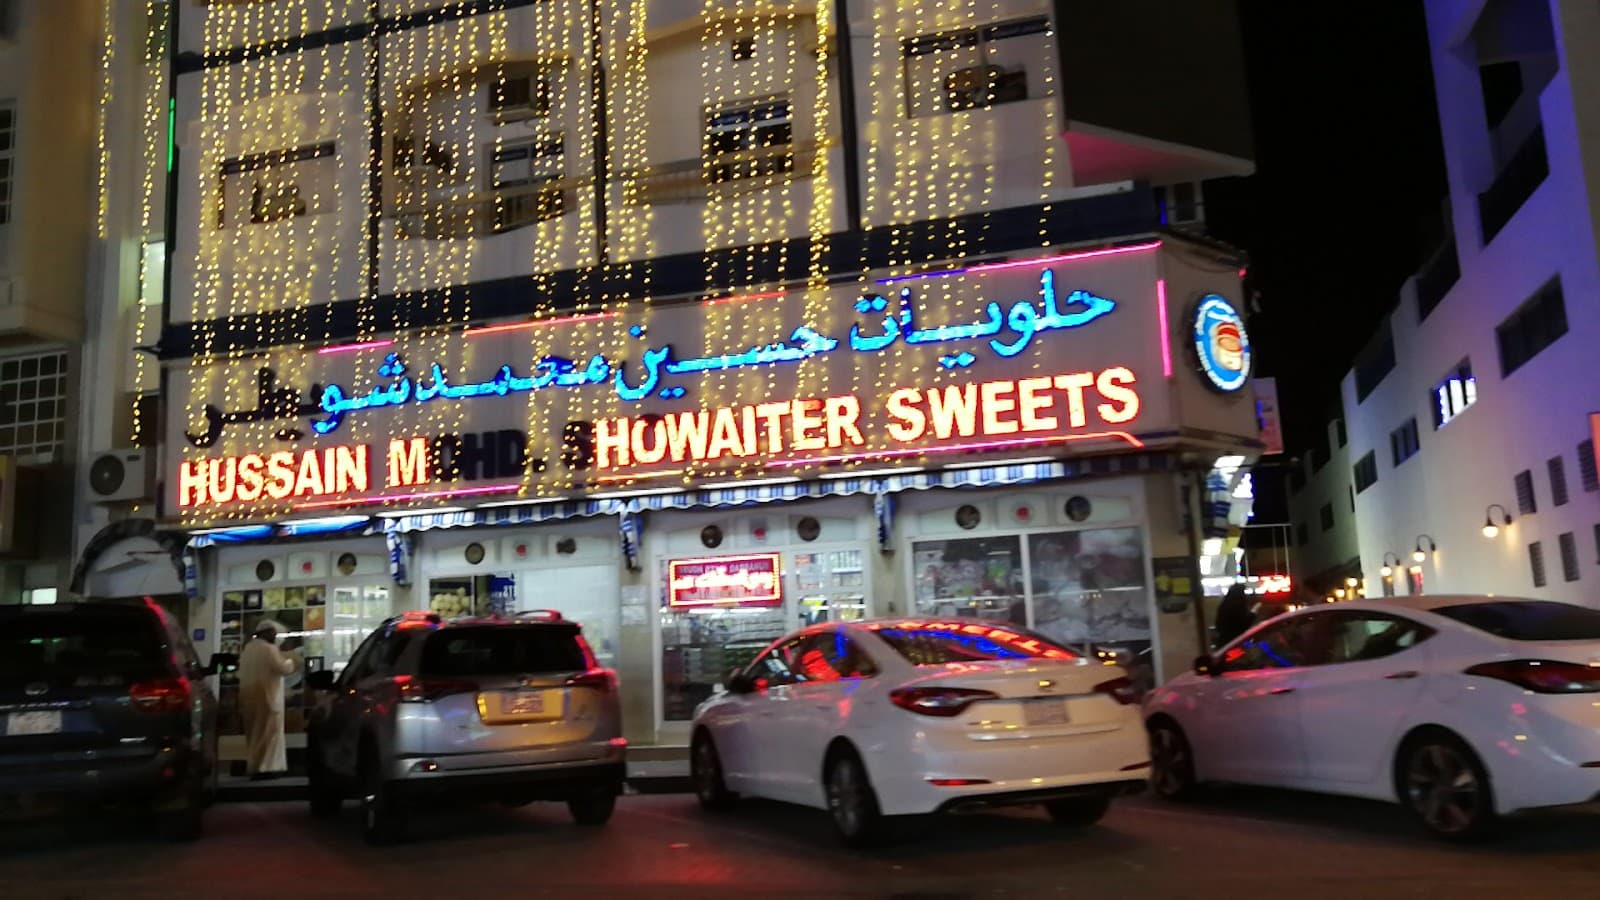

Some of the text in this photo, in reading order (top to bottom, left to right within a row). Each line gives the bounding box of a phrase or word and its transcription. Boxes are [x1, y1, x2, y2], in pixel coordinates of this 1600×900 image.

[613, 323, 840, 401] حسين
[849, 268, 1116, 370] حلويات
[414, 354, 611, 402] محمد
[178, 443, 369, 507] HUSSAIN
[560, 394, 866, 472] SHOWAITER
[884, 367, 1140, 443] SWEETS
